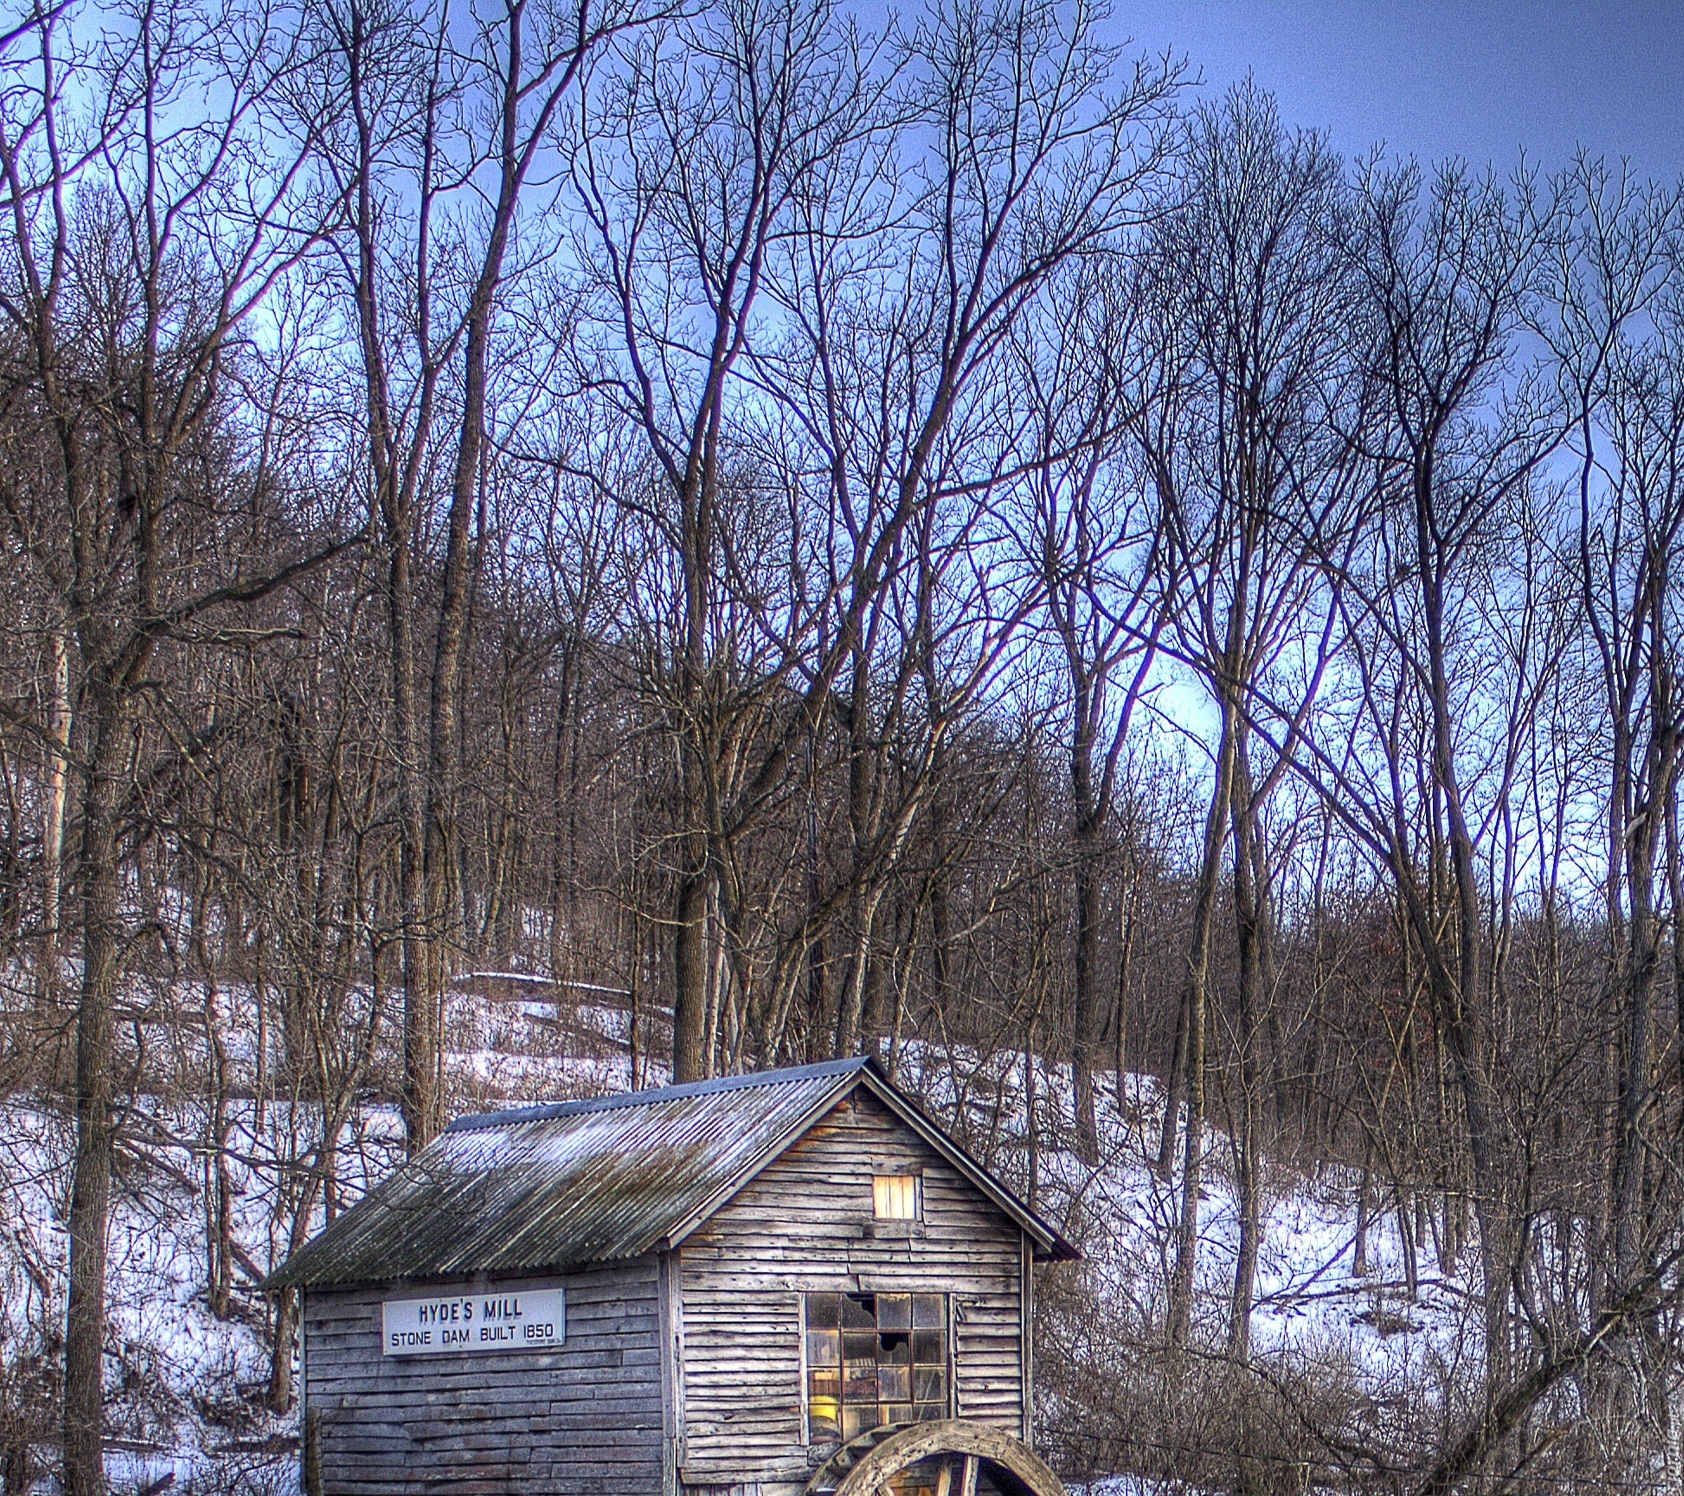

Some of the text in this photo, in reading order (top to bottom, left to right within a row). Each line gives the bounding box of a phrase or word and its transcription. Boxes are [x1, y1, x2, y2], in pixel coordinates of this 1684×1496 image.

[419, 1298, 523, 1322] HYDE'S MILL
[391, 1323, 554, 1346] STONE DAM BUILT 1850
